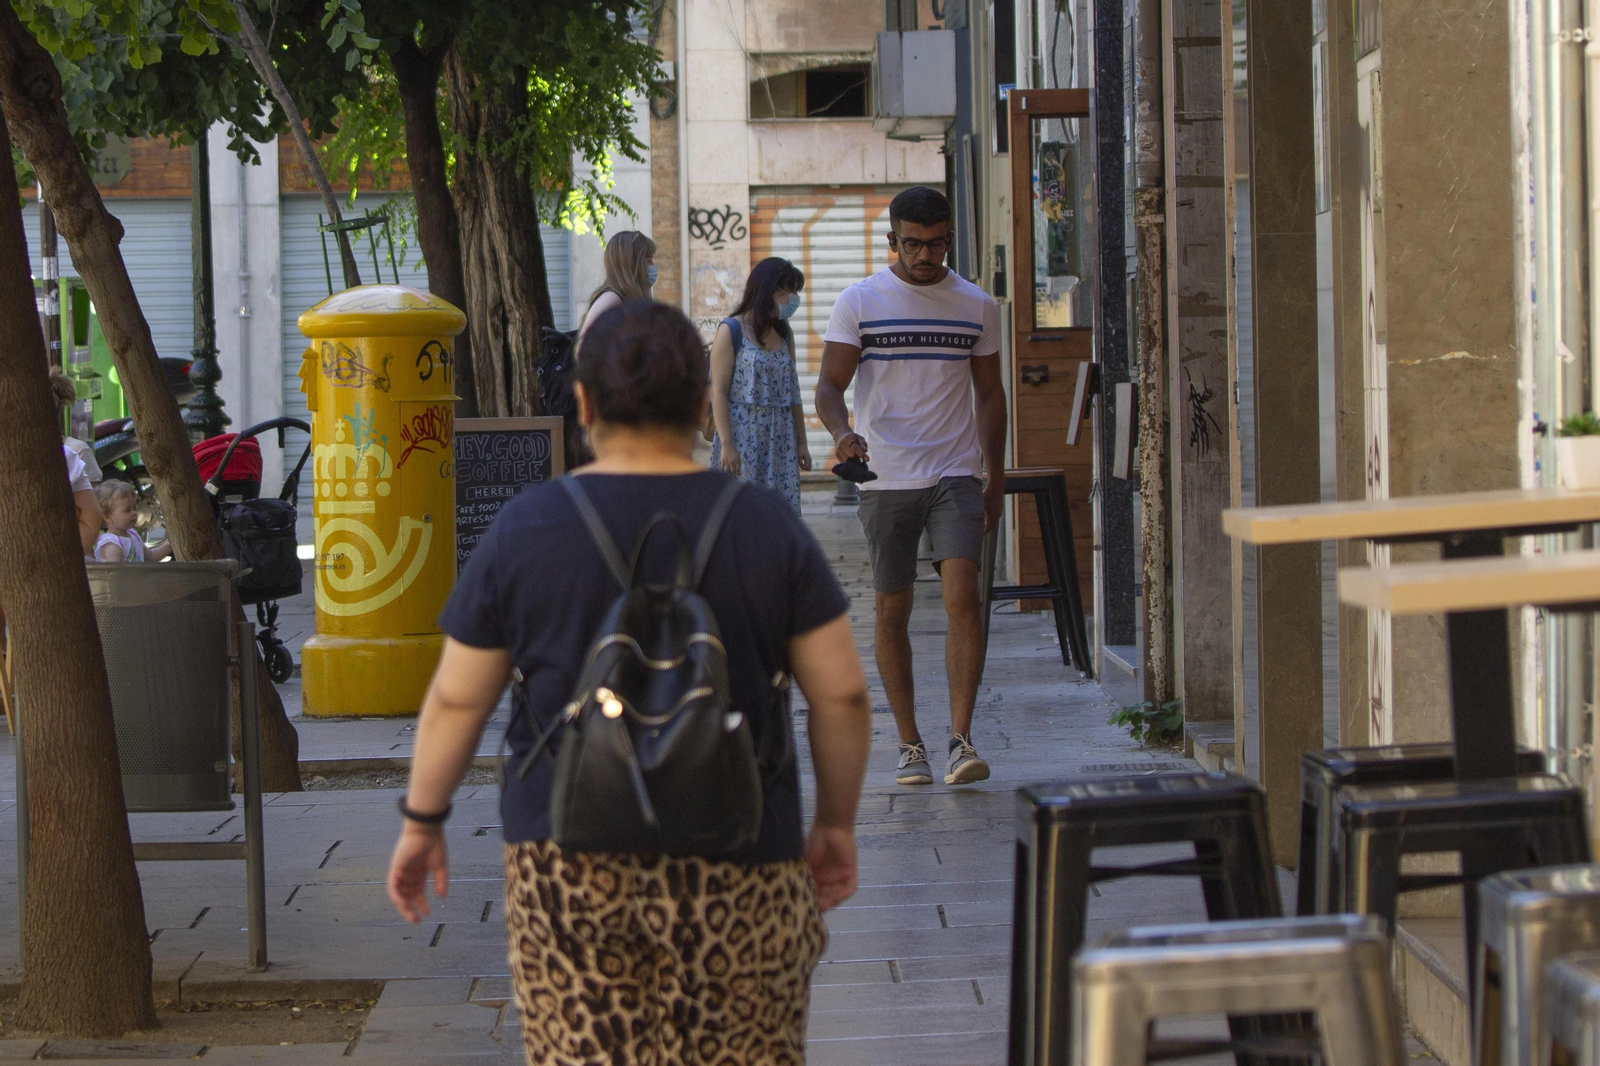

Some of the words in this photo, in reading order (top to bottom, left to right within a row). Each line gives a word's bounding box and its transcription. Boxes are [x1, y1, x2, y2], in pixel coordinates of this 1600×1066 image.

[875, 335, 914, 345] TOMMY
[920, 335, 972, 345] HILFIGER
[492, 432, 551, 462] GOOD
[455, 461, 544, 483] COFFEE
[332, 553, 345, 561] 197
